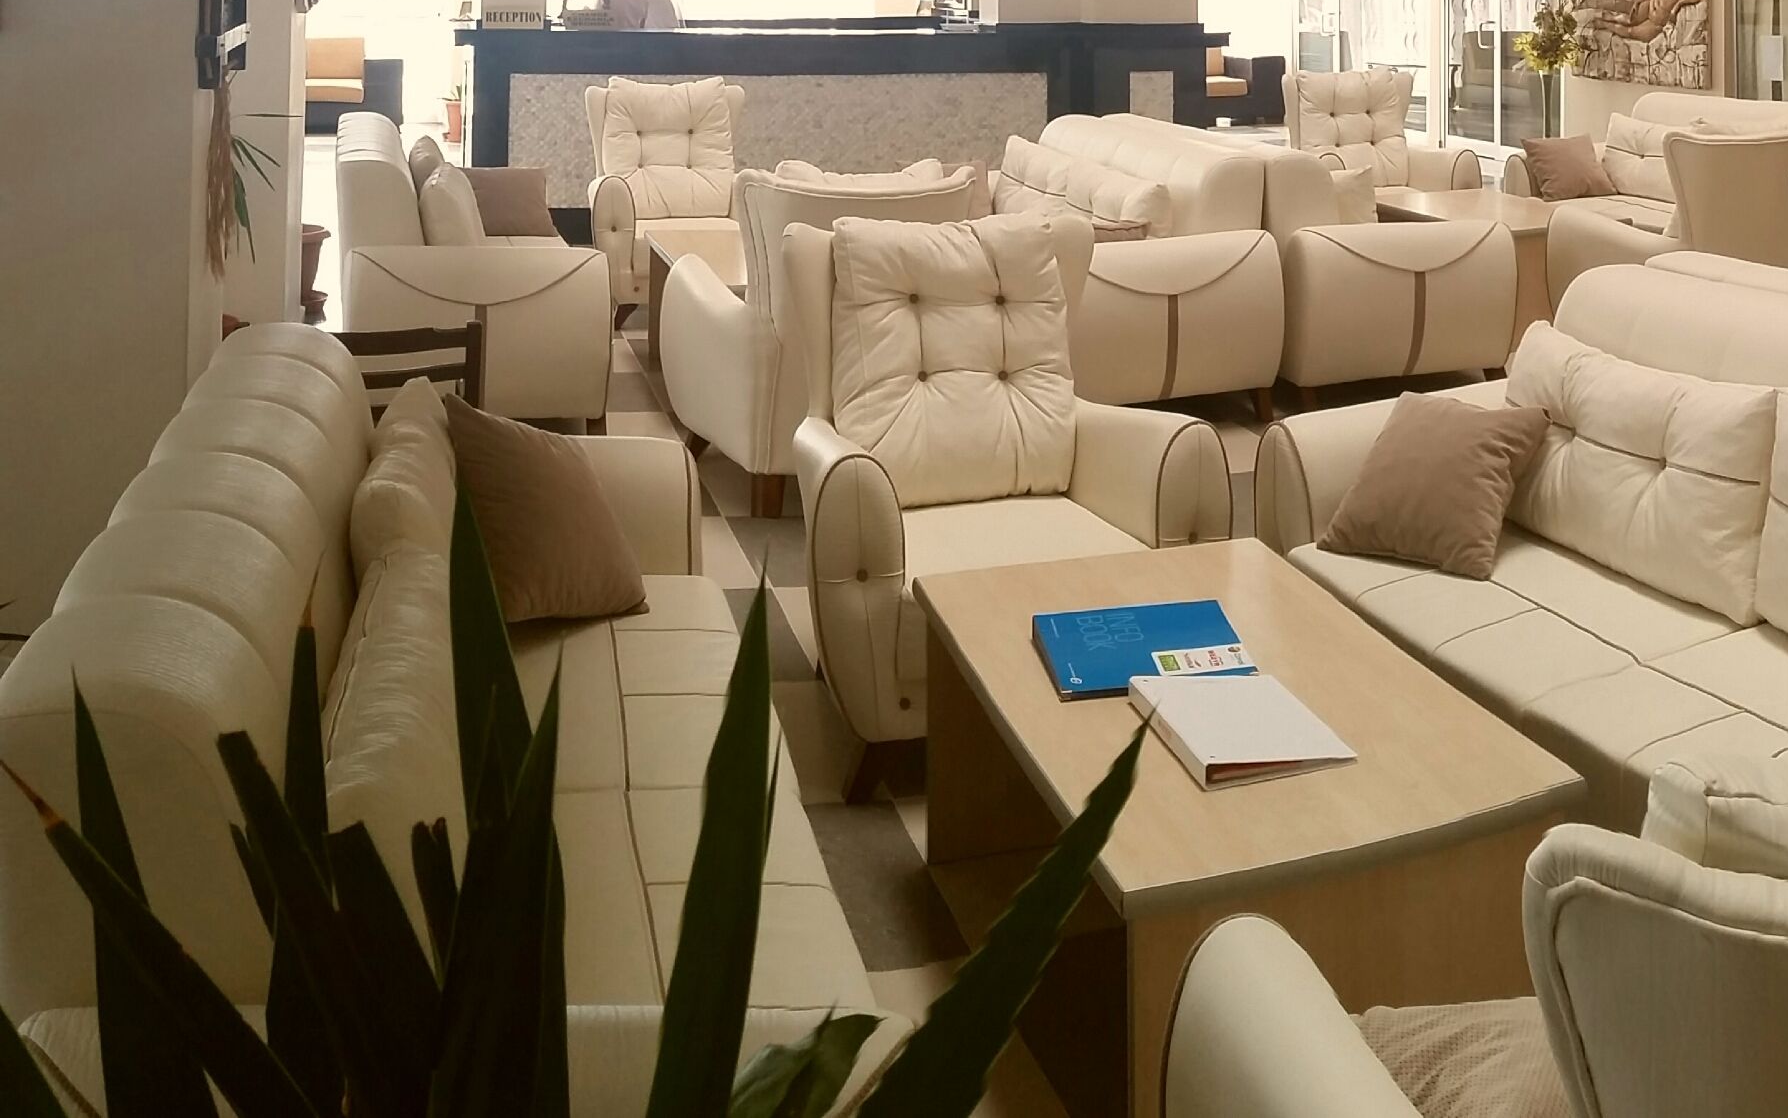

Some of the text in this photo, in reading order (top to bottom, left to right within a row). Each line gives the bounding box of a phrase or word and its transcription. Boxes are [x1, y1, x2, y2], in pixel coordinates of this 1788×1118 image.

[485, 11, 542, 24] RECEPTION
[1076, 614, 1118, 651] BOOK
[1104, 611, 1145, 643] INFO
